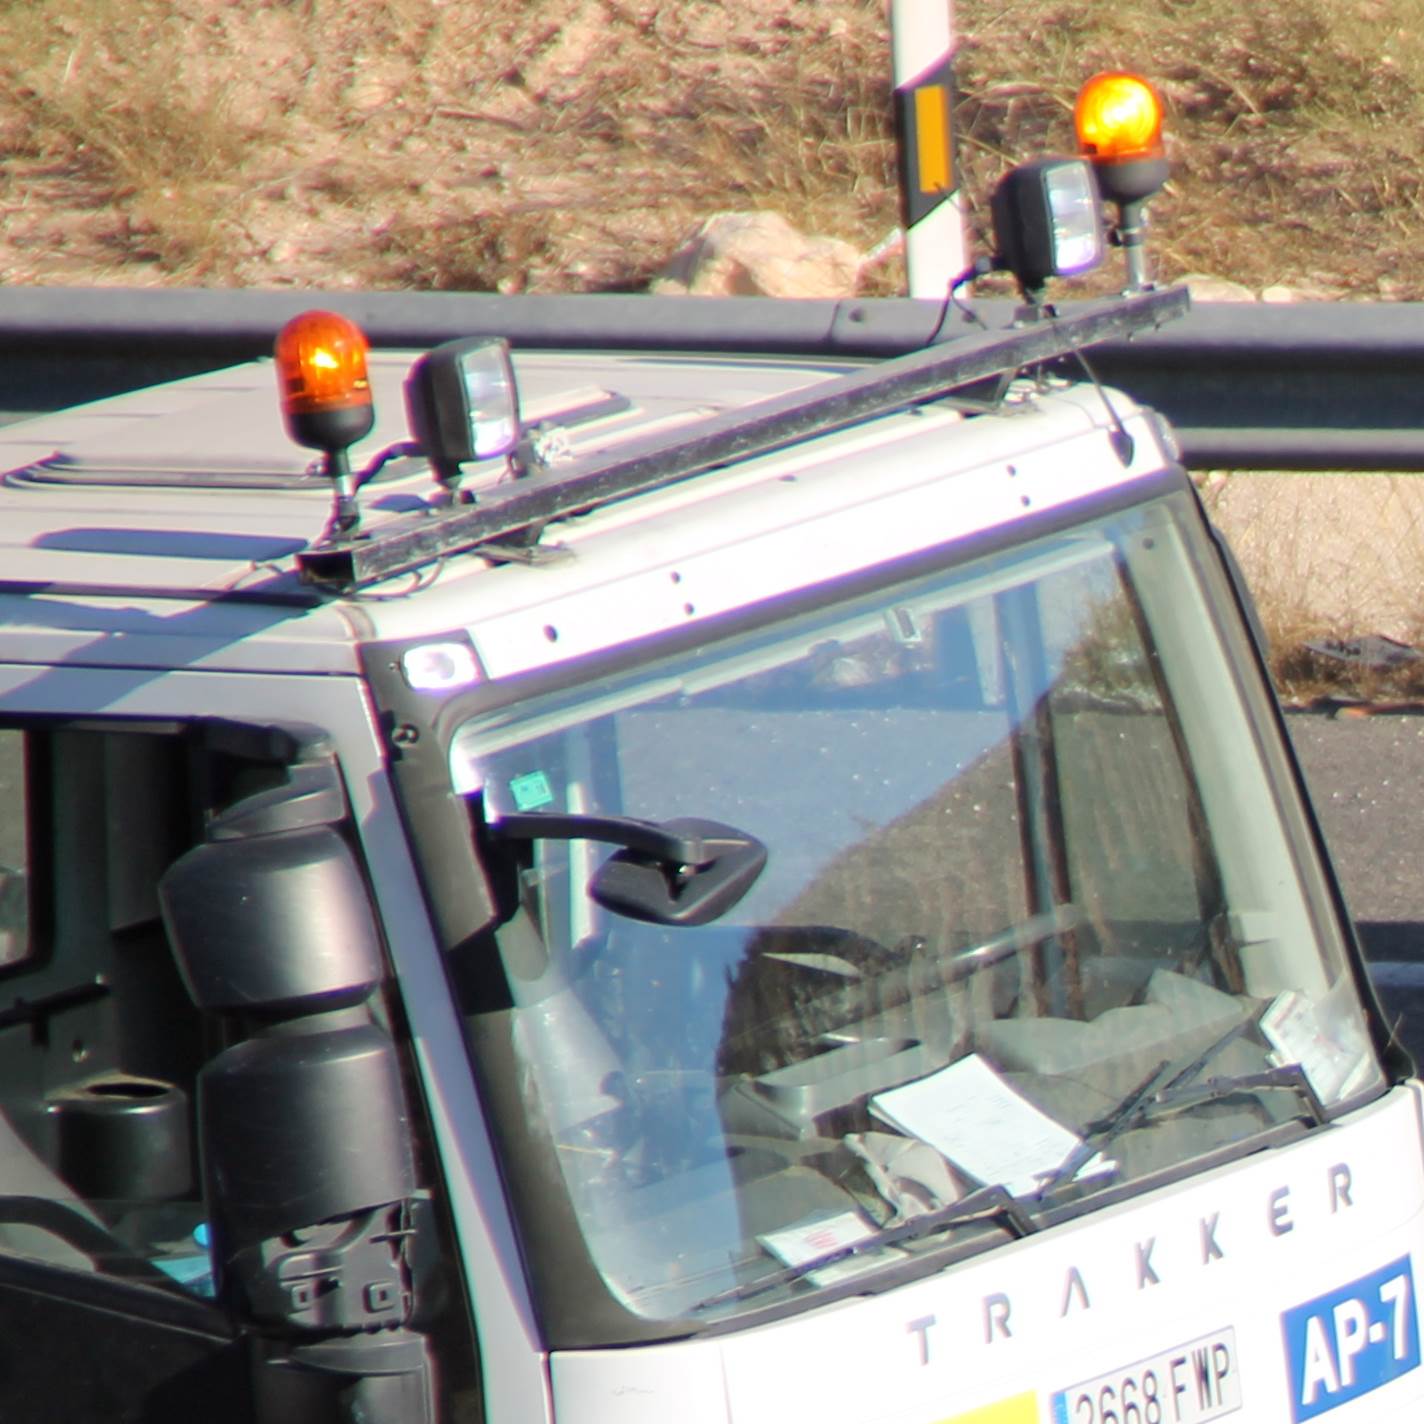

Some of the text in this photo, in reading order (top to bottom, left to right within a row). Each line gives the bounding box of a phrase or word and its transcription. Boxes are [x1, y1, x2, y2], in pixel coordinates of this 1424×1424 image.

[906, 1162, 1354, 1367] TRAKKER
[1169, 1342, 1230, 1422] FWP
[1299, 1272, 1413, 1407] AP-7
